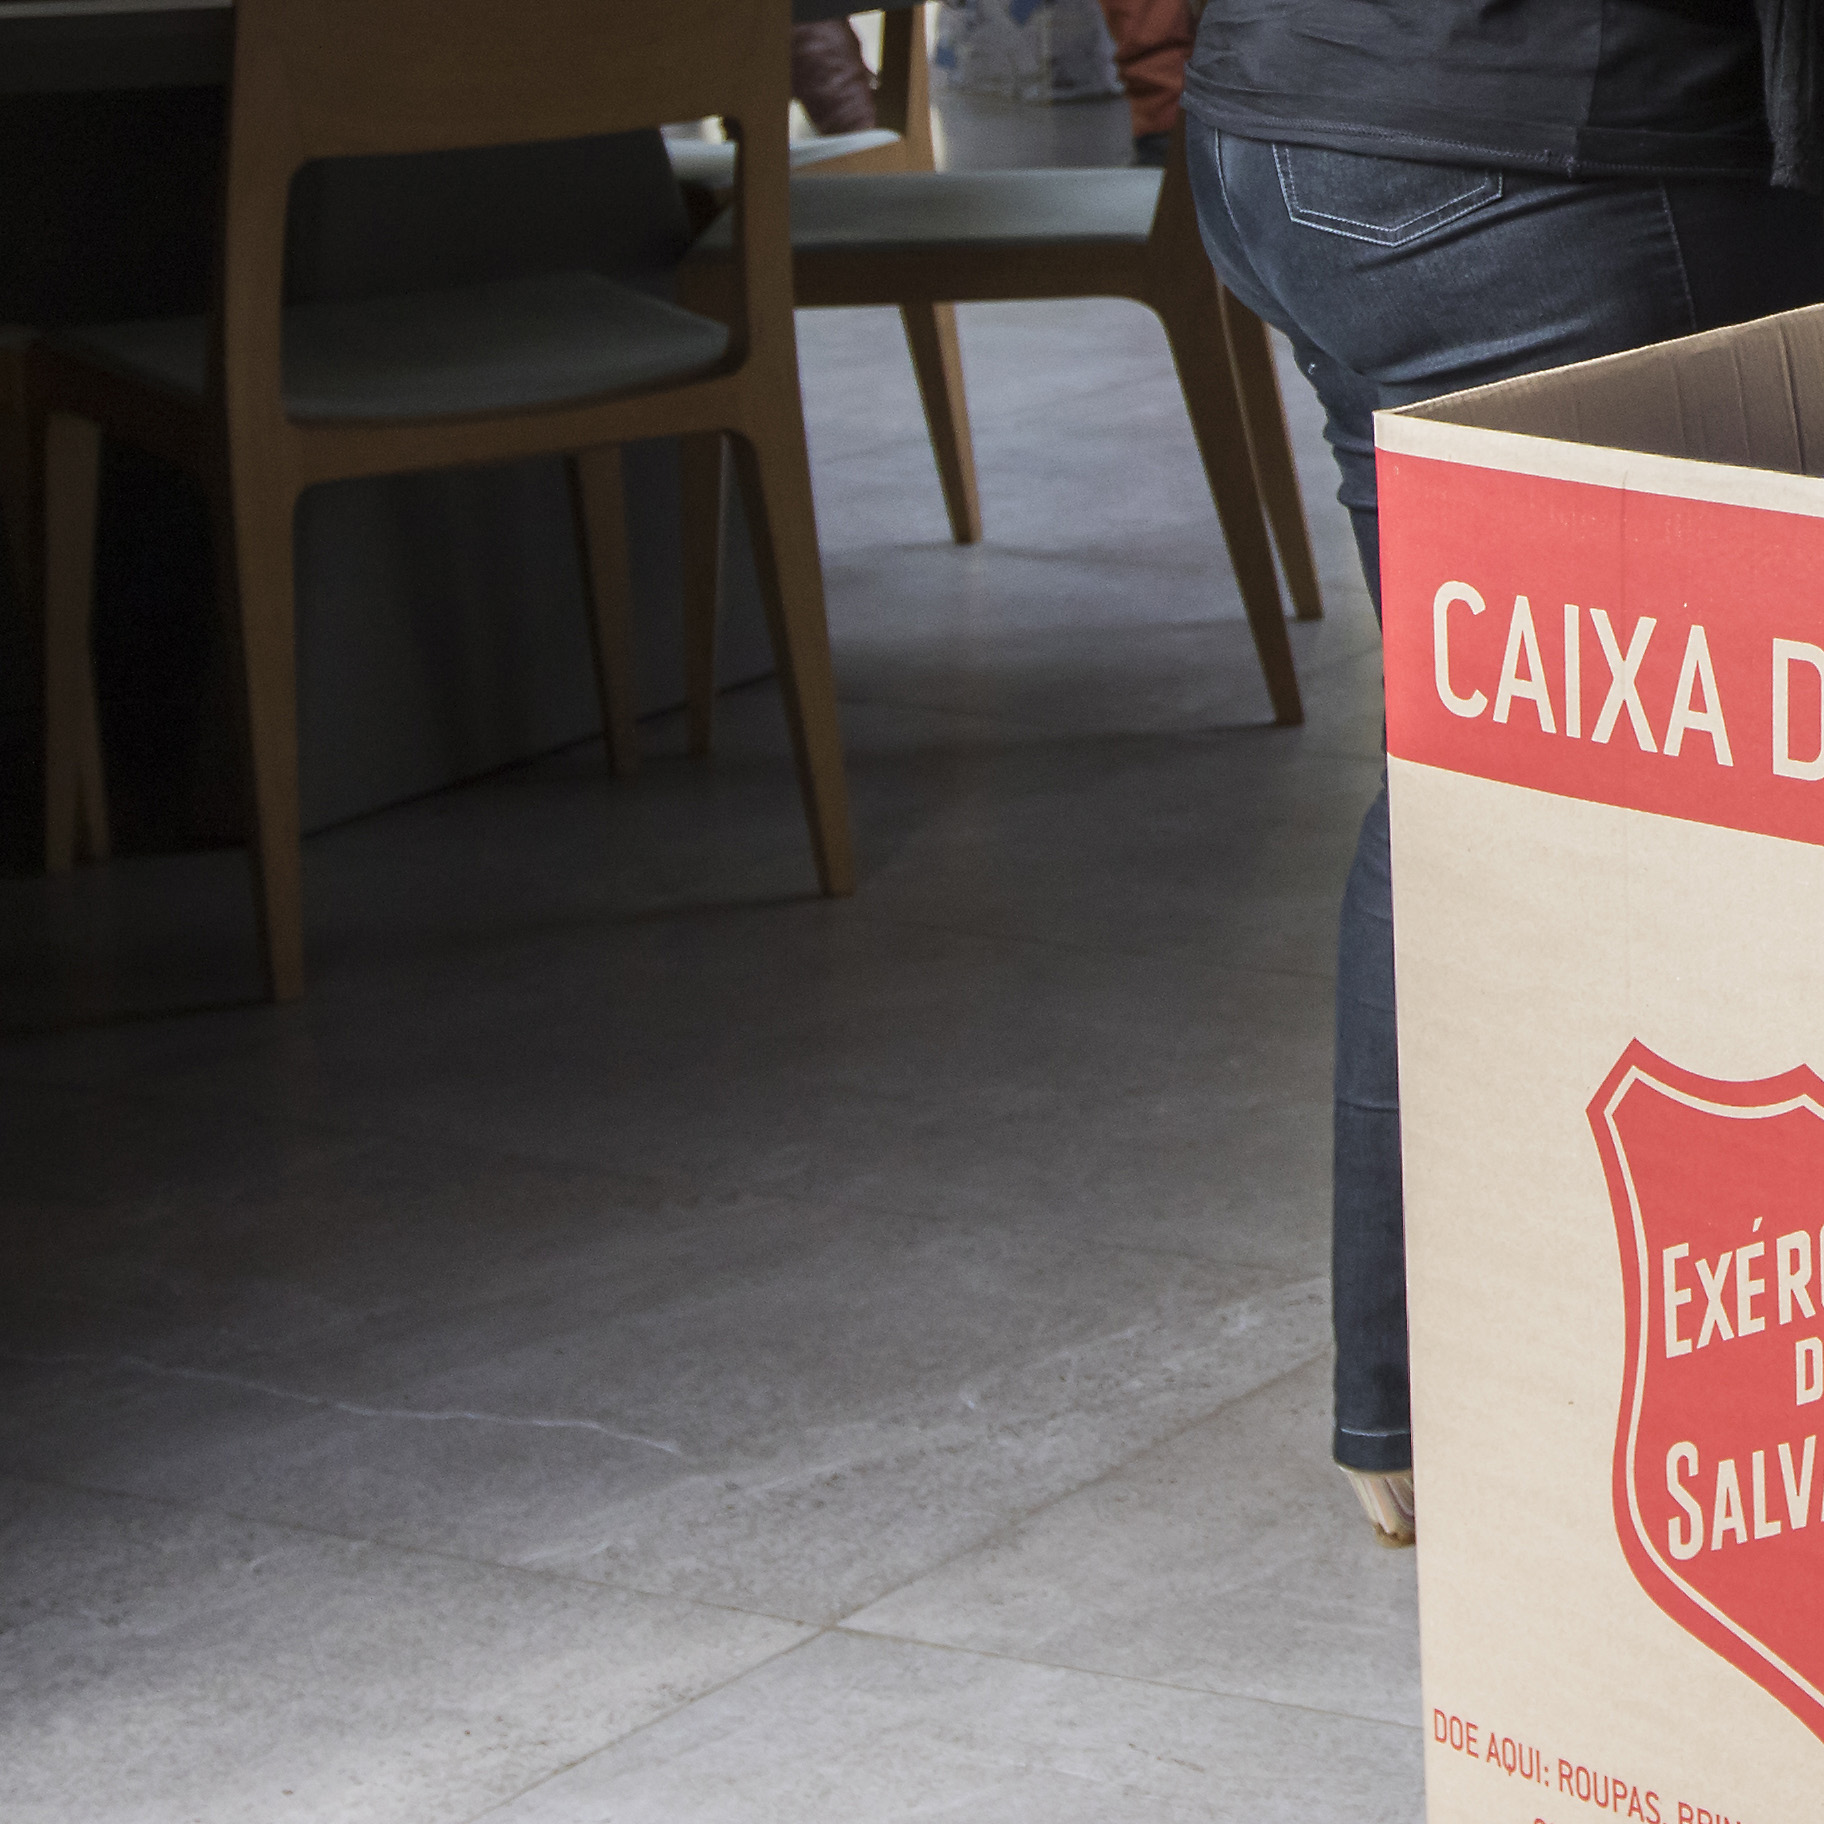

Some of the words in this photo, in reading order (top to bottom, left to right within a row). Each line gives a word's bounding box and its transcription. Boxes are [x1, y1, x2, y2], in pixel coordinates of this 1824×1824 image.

[1432, 580, 1733, 767] CAIXA
[1434, 1708, 1479, 1758] DOE
[1486, 1732, 1549, 1787] AQUI:
[1558, 1758, 1666, 1824] ROUPAS
